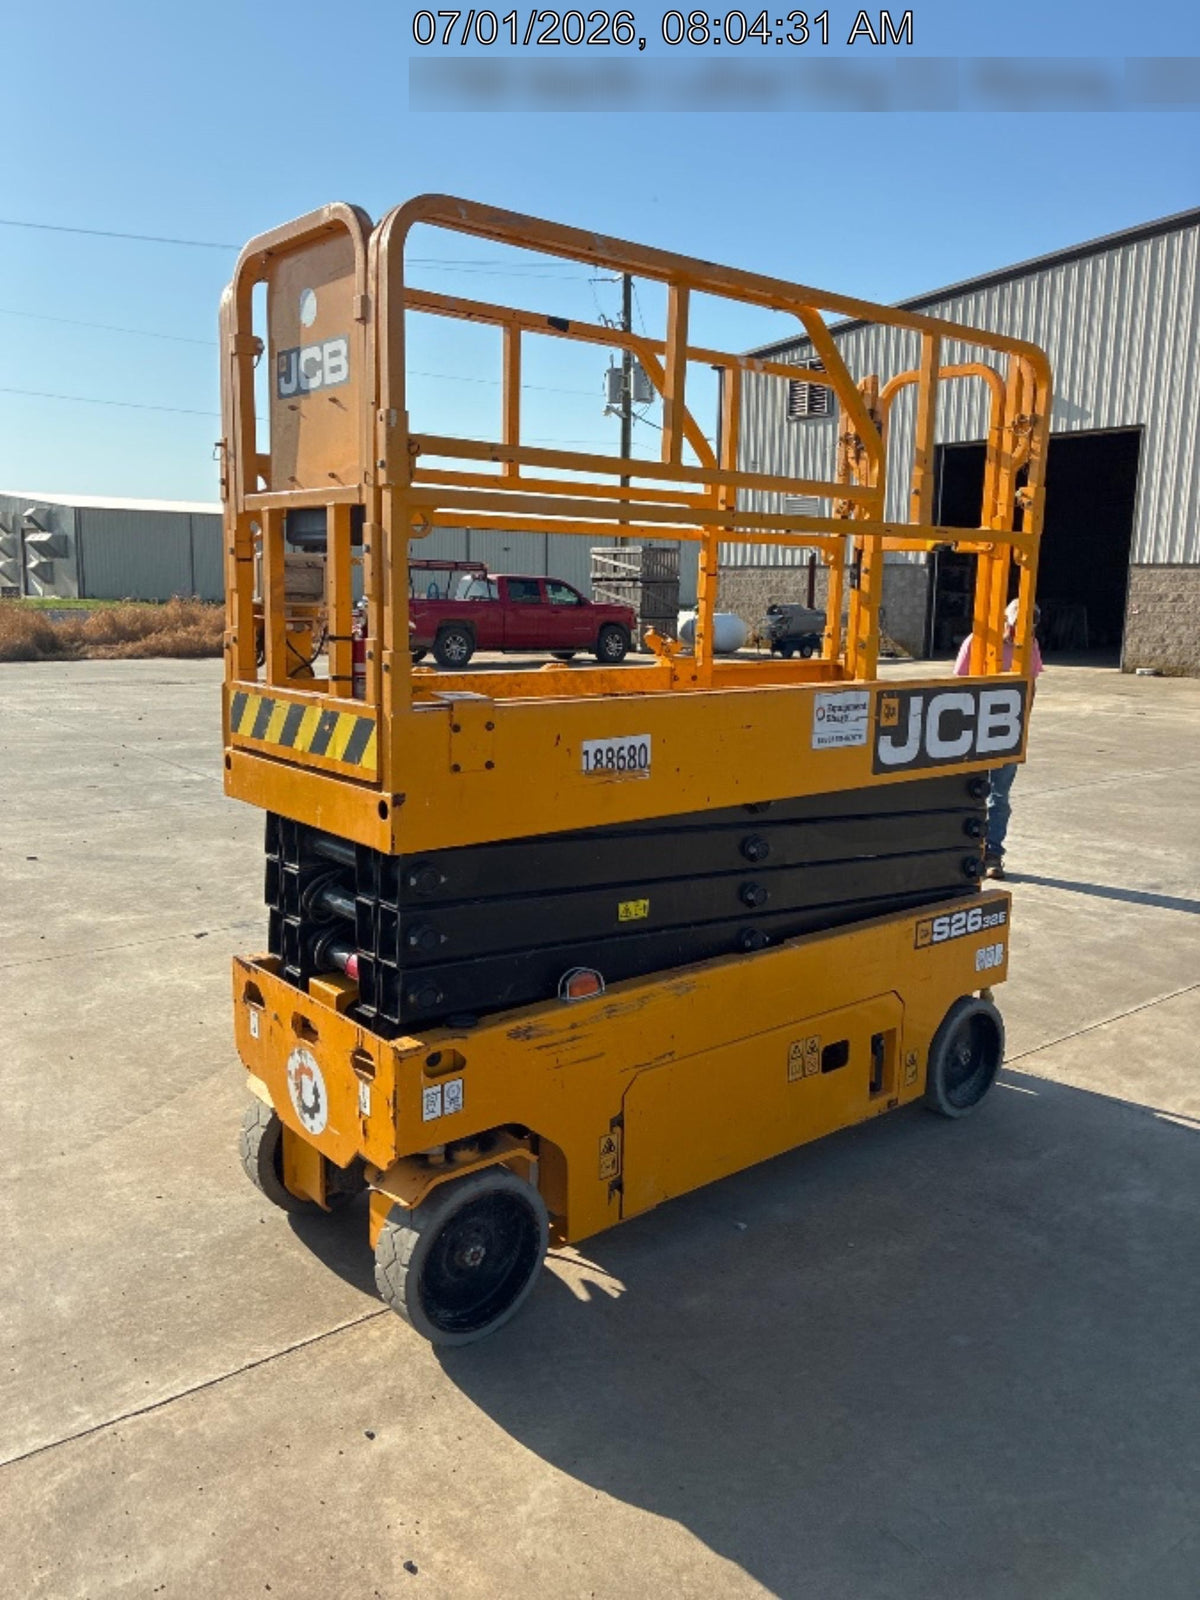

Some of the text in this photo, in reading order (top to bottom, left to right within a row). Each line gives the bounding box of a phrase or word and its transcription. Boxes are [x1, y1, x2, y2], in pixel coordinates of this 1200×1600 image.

[279, 339, 349, 395] JCB
[878, 689, 1022, 765] JCB
[582, 742, 648, 771] 188680
